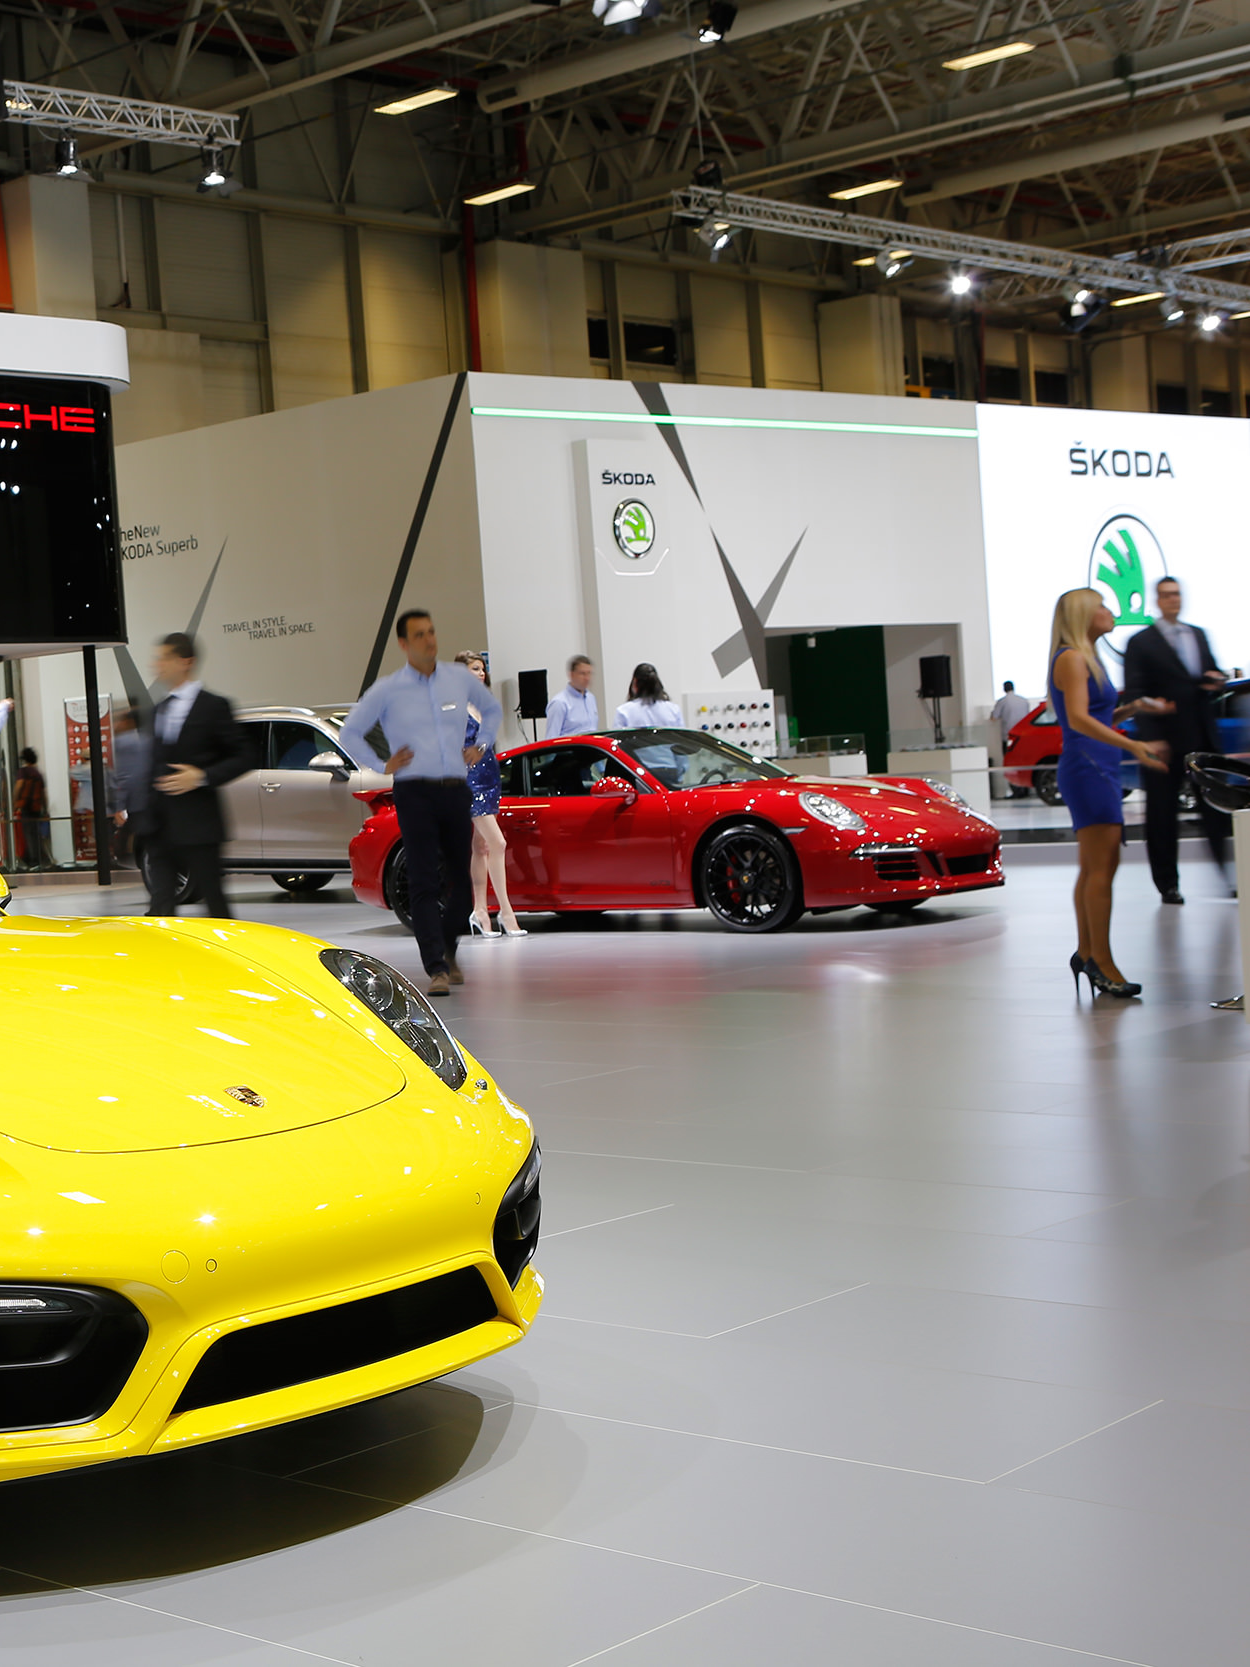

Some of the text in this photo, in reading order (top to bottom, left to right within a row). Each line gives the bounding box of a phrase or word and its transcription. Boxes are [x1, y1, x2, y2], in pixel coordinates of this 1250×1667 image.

[1069, 440, 1175, 478] ŠKODA
[601, 468, 656, 486] ŠKODA
[119, 525, 160, 542] heNew
[121, 534, 198, 561] KODA Superb
[222, 621, 251, 633] TRAVEL
[252, 619, 261, 629] IN
[248, 627, 277, 640] TRAVEL
[279, 626, 287, 636] IN
